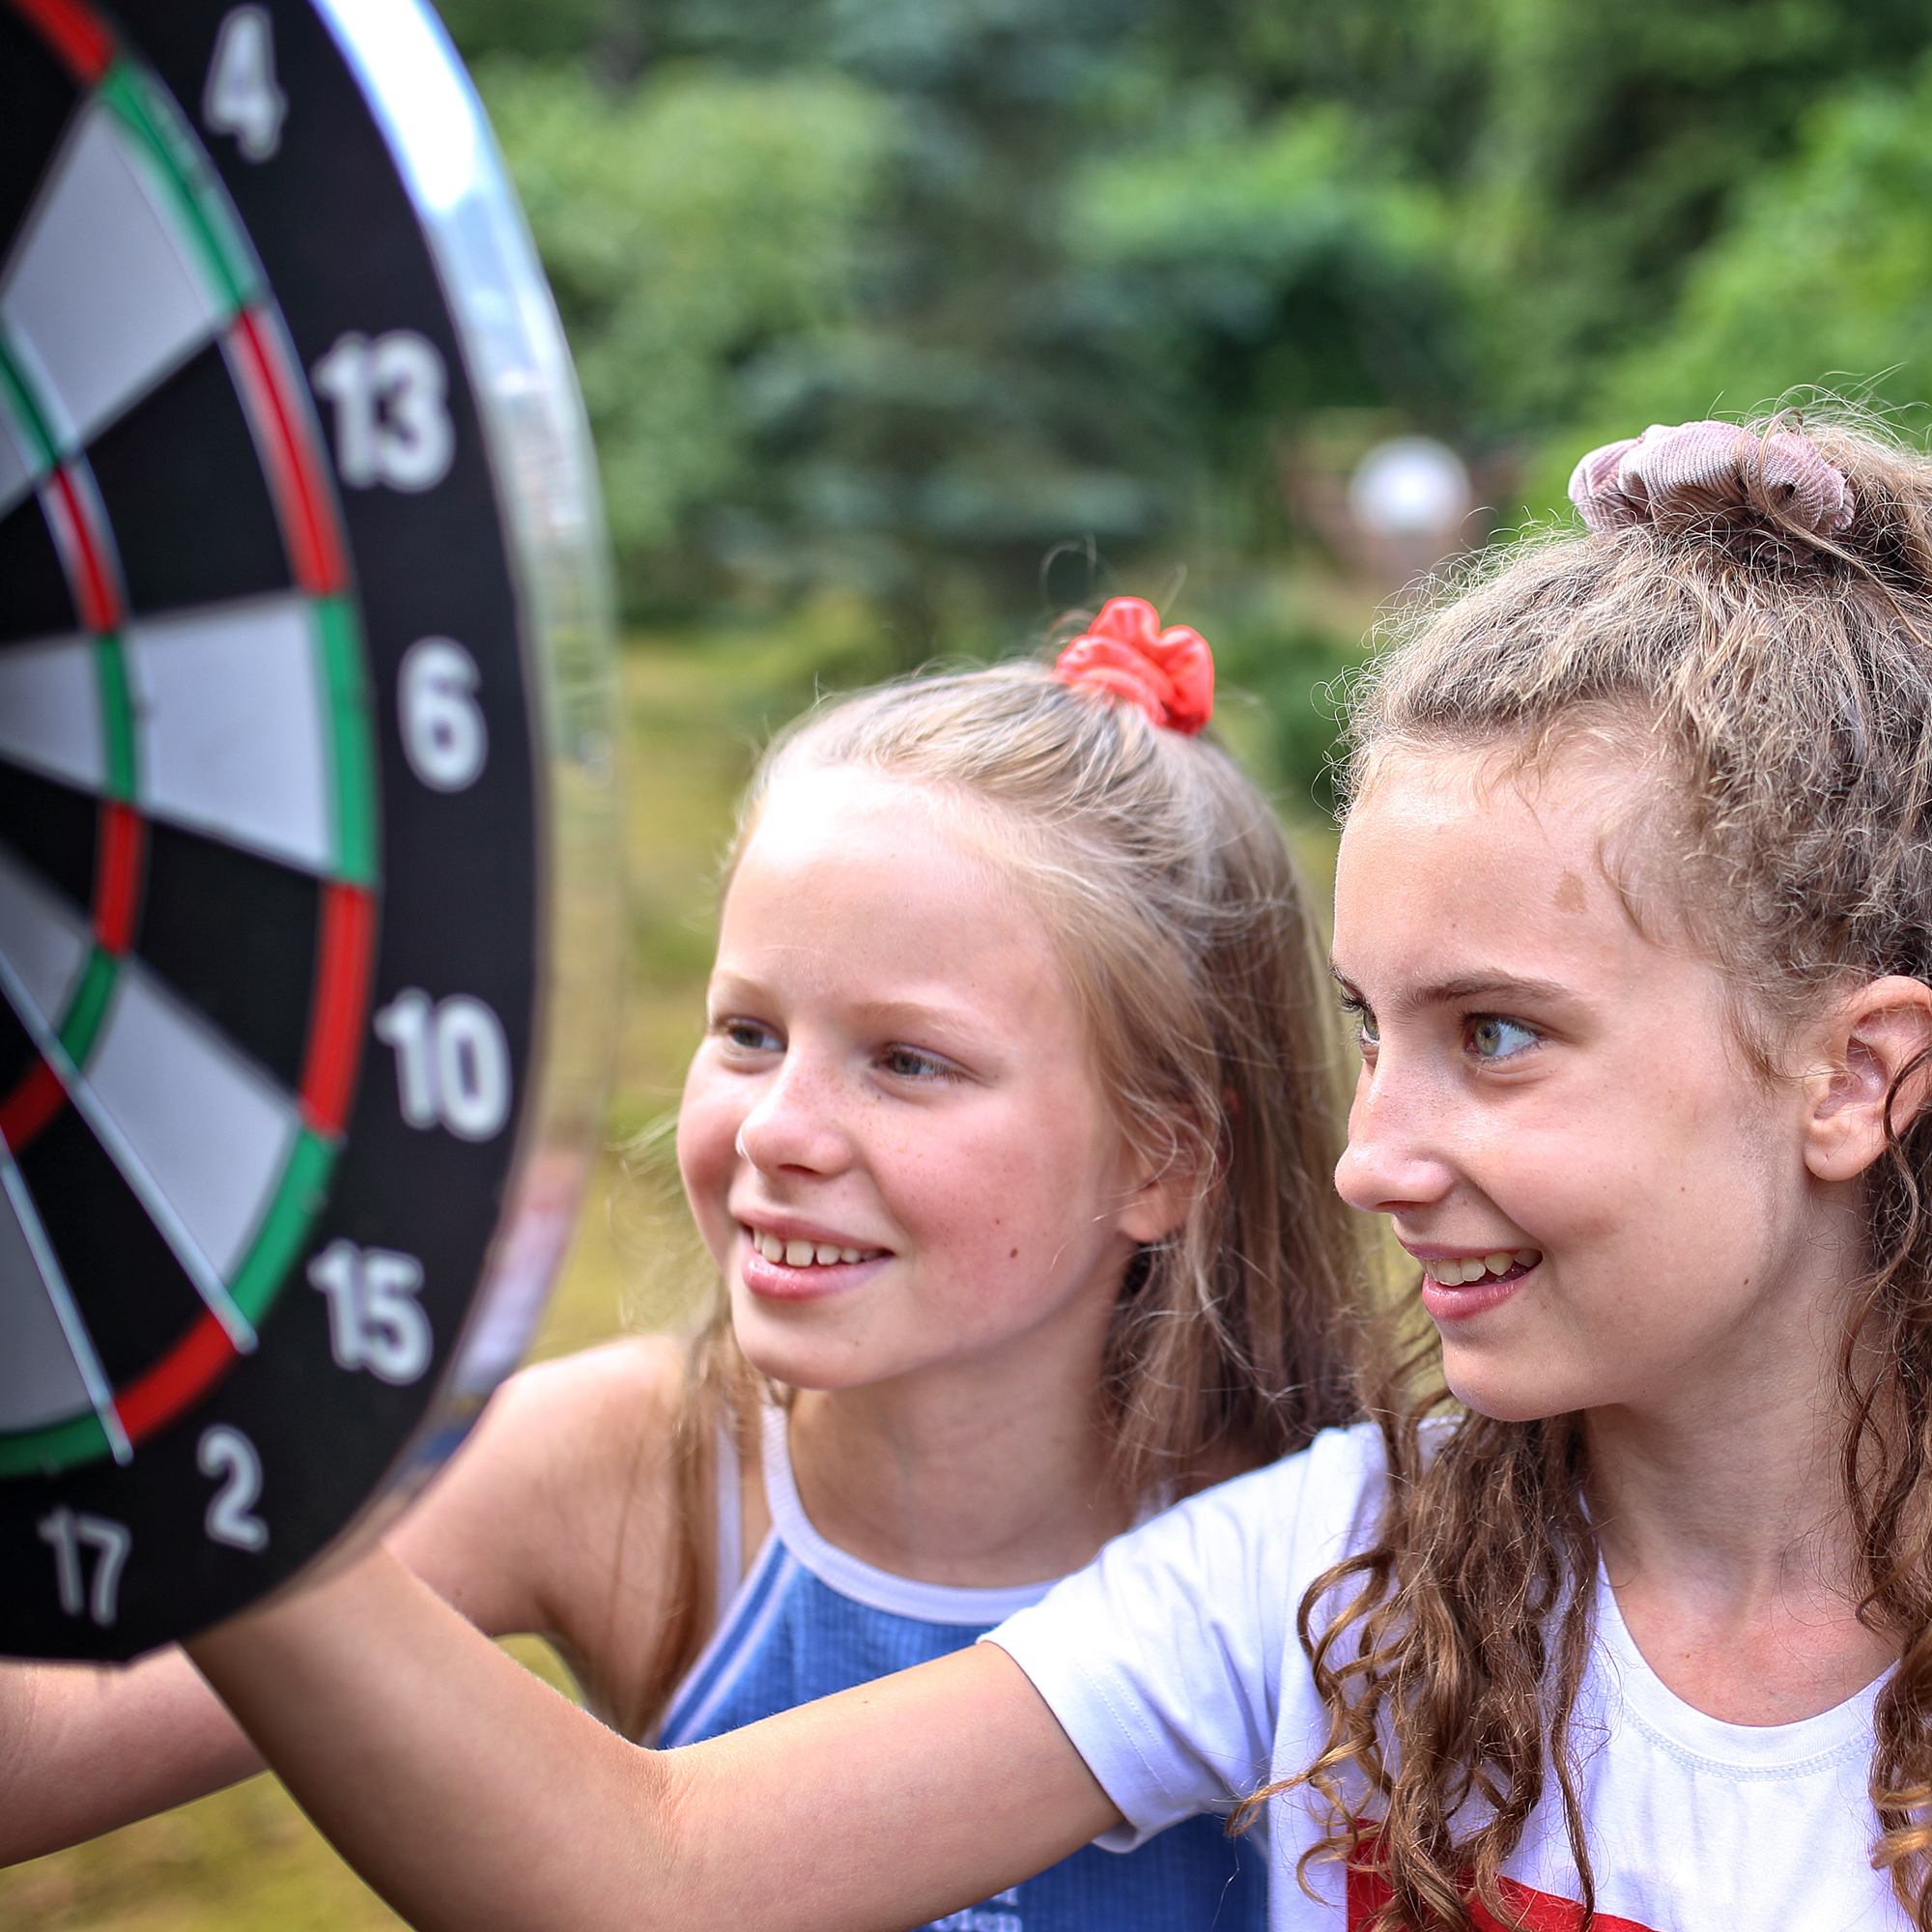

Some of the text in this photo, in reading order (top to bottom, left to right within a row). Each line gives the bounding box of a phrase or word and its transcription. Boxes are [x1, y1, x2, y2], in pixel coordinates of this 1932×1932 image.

[206, 6, 286, 160] 4
[313, 330, 455, 493] 13
[398, 637, 488, 792] 6
[374, 987, 512, 1142] 10
[308, 1240, 433, 1384] 15
[198, 1425, 269, 1550] 2
[38, 1508, 130, 1624] 17
